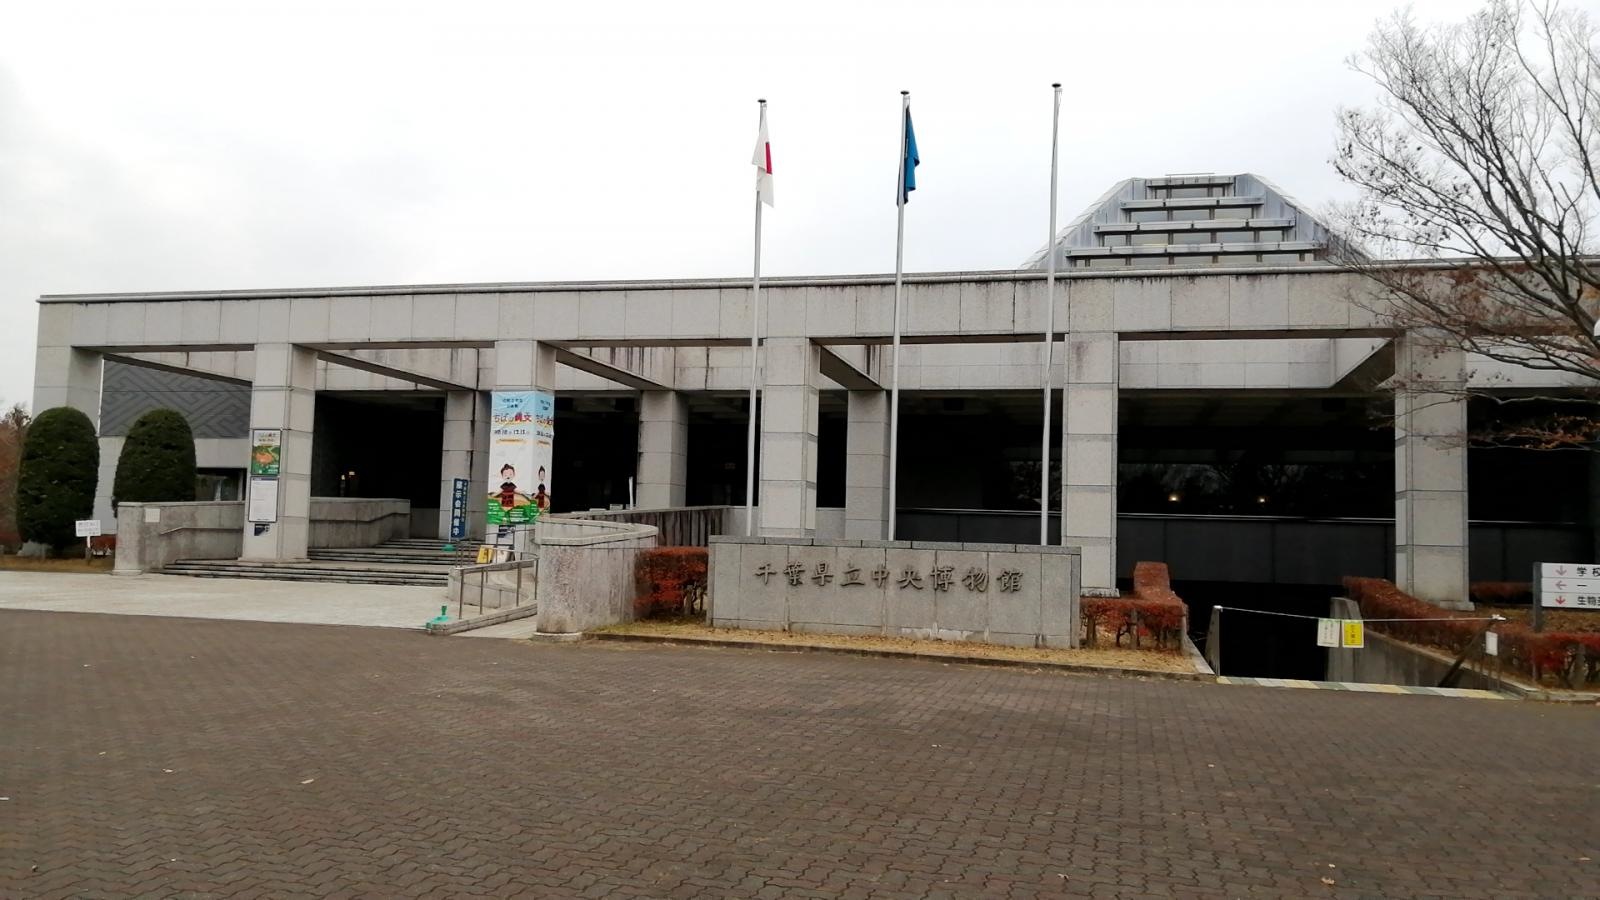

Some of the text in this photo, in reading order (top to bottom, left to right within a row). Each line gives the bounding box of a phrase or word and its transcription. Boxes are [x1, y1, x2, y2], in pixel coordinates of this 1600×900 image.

[755, 561, 1023, 592] 千葉県立中央博物館
